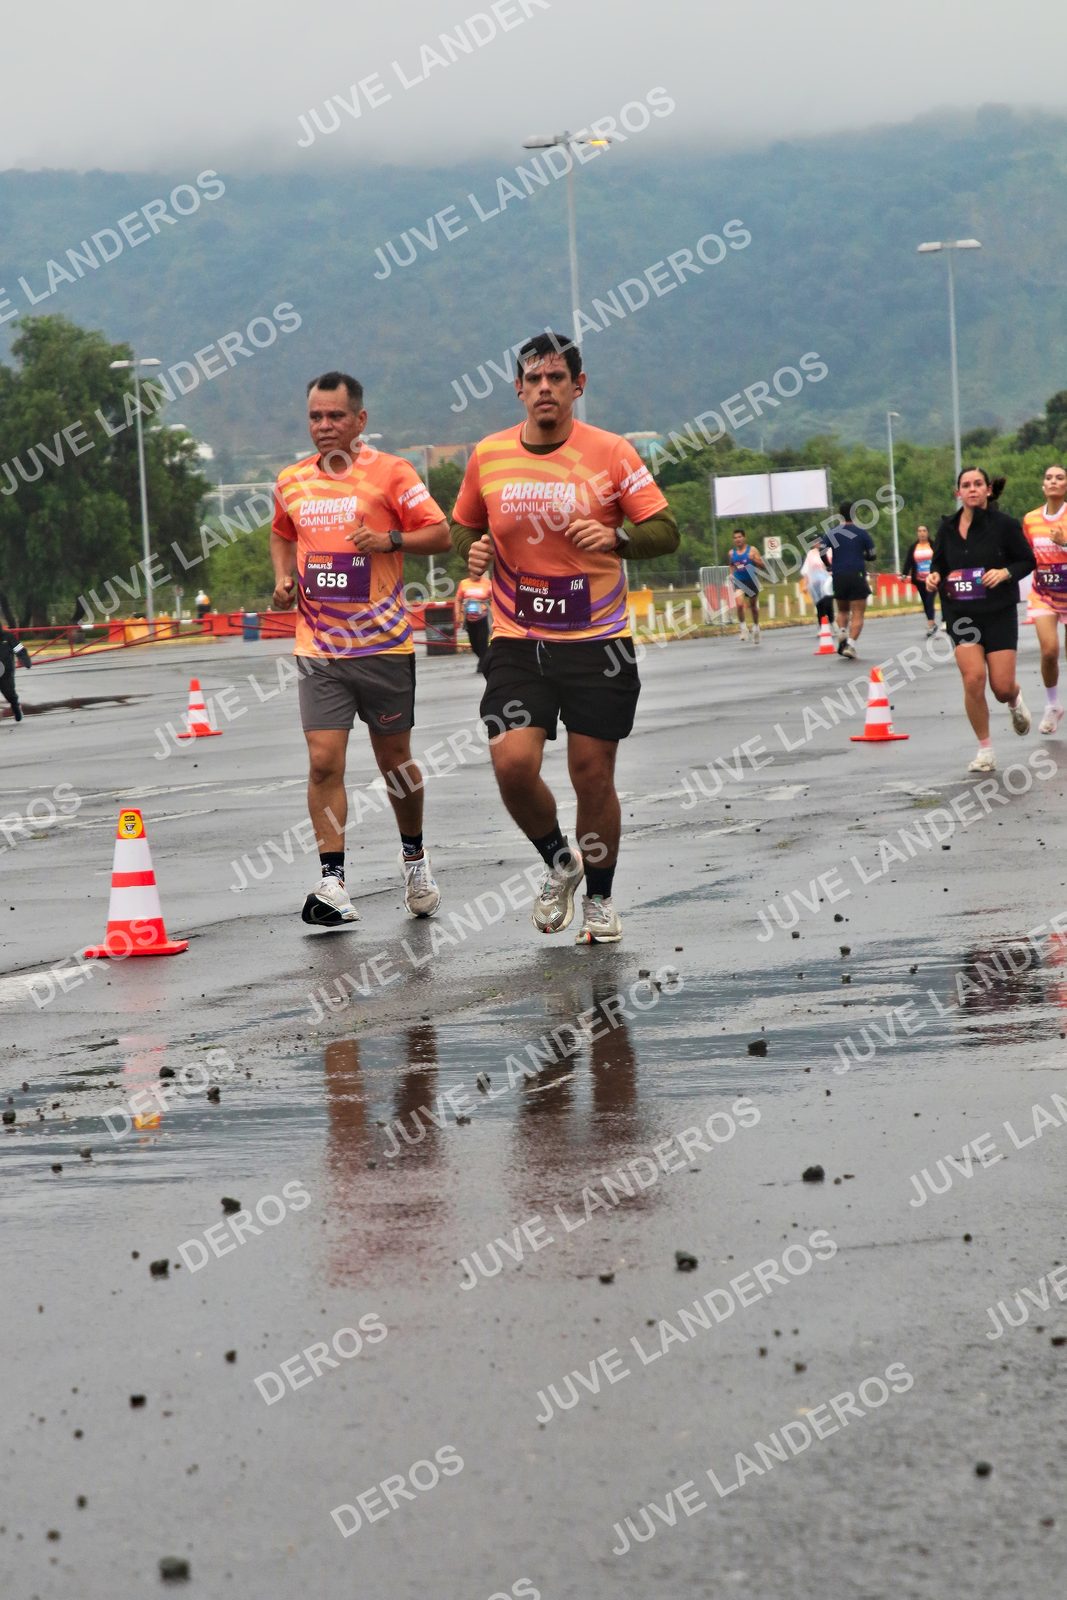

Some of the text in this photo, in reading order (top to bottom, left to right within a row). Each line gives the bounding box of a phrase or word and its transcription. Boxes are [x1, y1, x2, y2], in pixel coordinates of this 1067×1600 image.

[501, 482, 576, 500] CARRERA
[300, 496, 357, 516] CARRERA
[501, 501, 559, 514] OMNILIFE
[300, 514, 343, 527] OMNILIFE
[352, 556, 365, 567] 15K
[317, 572, 348, 588] 658
[570, 579, 584, 590] 15K
[1043, 574, 1060, 583] 122
[954, 581, 973, 592] 155
[533, 597, 566, 614] 671
